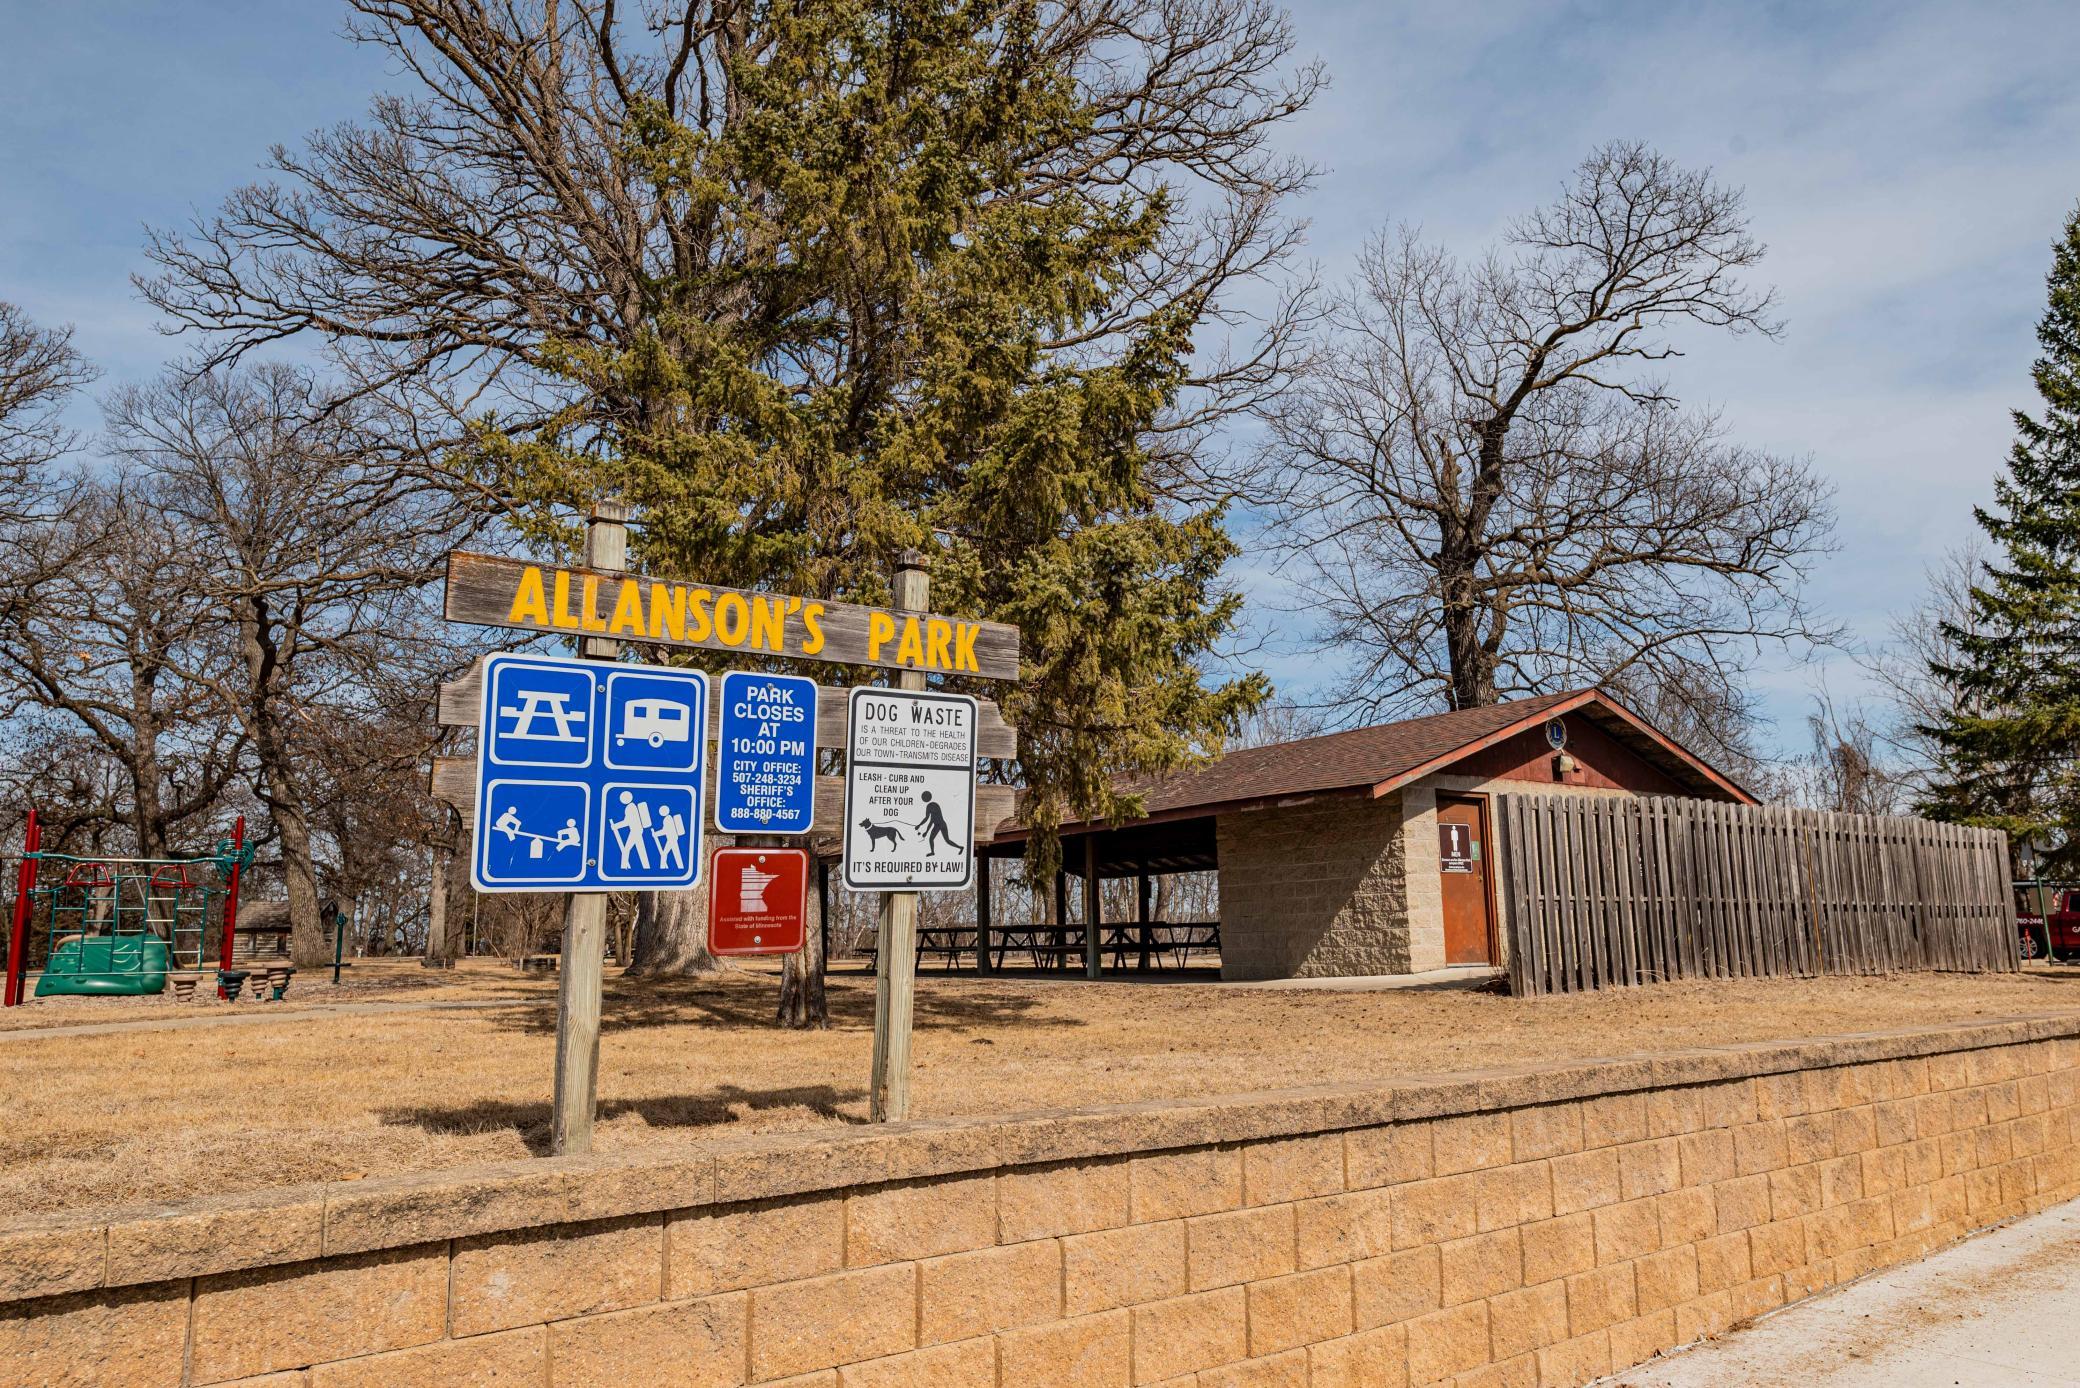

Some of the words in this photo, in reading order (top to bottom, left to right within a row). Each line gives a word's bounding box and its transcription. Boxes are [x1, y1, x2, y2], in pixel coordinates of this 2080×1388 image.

[509, 566, 825, 656] ALLANSON'S
[867, 611, 981, 673] PARK
[746, 685, 794, 705] PARK
[734, 702, 805, 723] CLOSES
[865, 702, 898, 722] DOG
[911, 705, 963, 727] WASTE
[757, 721, 781, 738] AT
[861, 725, 868, 734] IS
[871, 726, 877, 734] A
[880, 726, 907, 736] THREAT
[911, 728, 920, 737] TO
[923, 729, 936, 738] THE
[940, 730, 966, 739] HEALTH
[731, 737, 776, 755] 10:00
[780, 740, 805, 756] PM
[859, 736, 869, 745] OF
[872, 737, 888, 746] OUR
[856, 748, 871, 757] OUR
[941, 752, 969, 762] DISEASE
[733, 760, 758, 772] CITY
[763, 761, 802, 774] OFFICE:
[732, 772, 802, 785] 507-248-3234
[859, 772, 882, 781] LEASH
[888, 773, 909, 783] CURB
[910, 775, 925, 783] AND
[740, 784, 794, 796] SHERIFF'S
[874, 784, 898, 794] CLEAN
[899, 785, 910, 794] UP
[746, 796, 786, 808] OFFICE:
[869, 796, 892, 805] AFTER
[894, 796, 914, 806] YOUR
[730, 807, 800, 820] 888-880-4567
[883, 808, 899, 817] DOG
[853, 861, 871, 873] IT'S
[874, 861, 922, 874] REQUIRED
[925, 861, 937, 873] BY
[940, 861, 964, 873] LAW!
